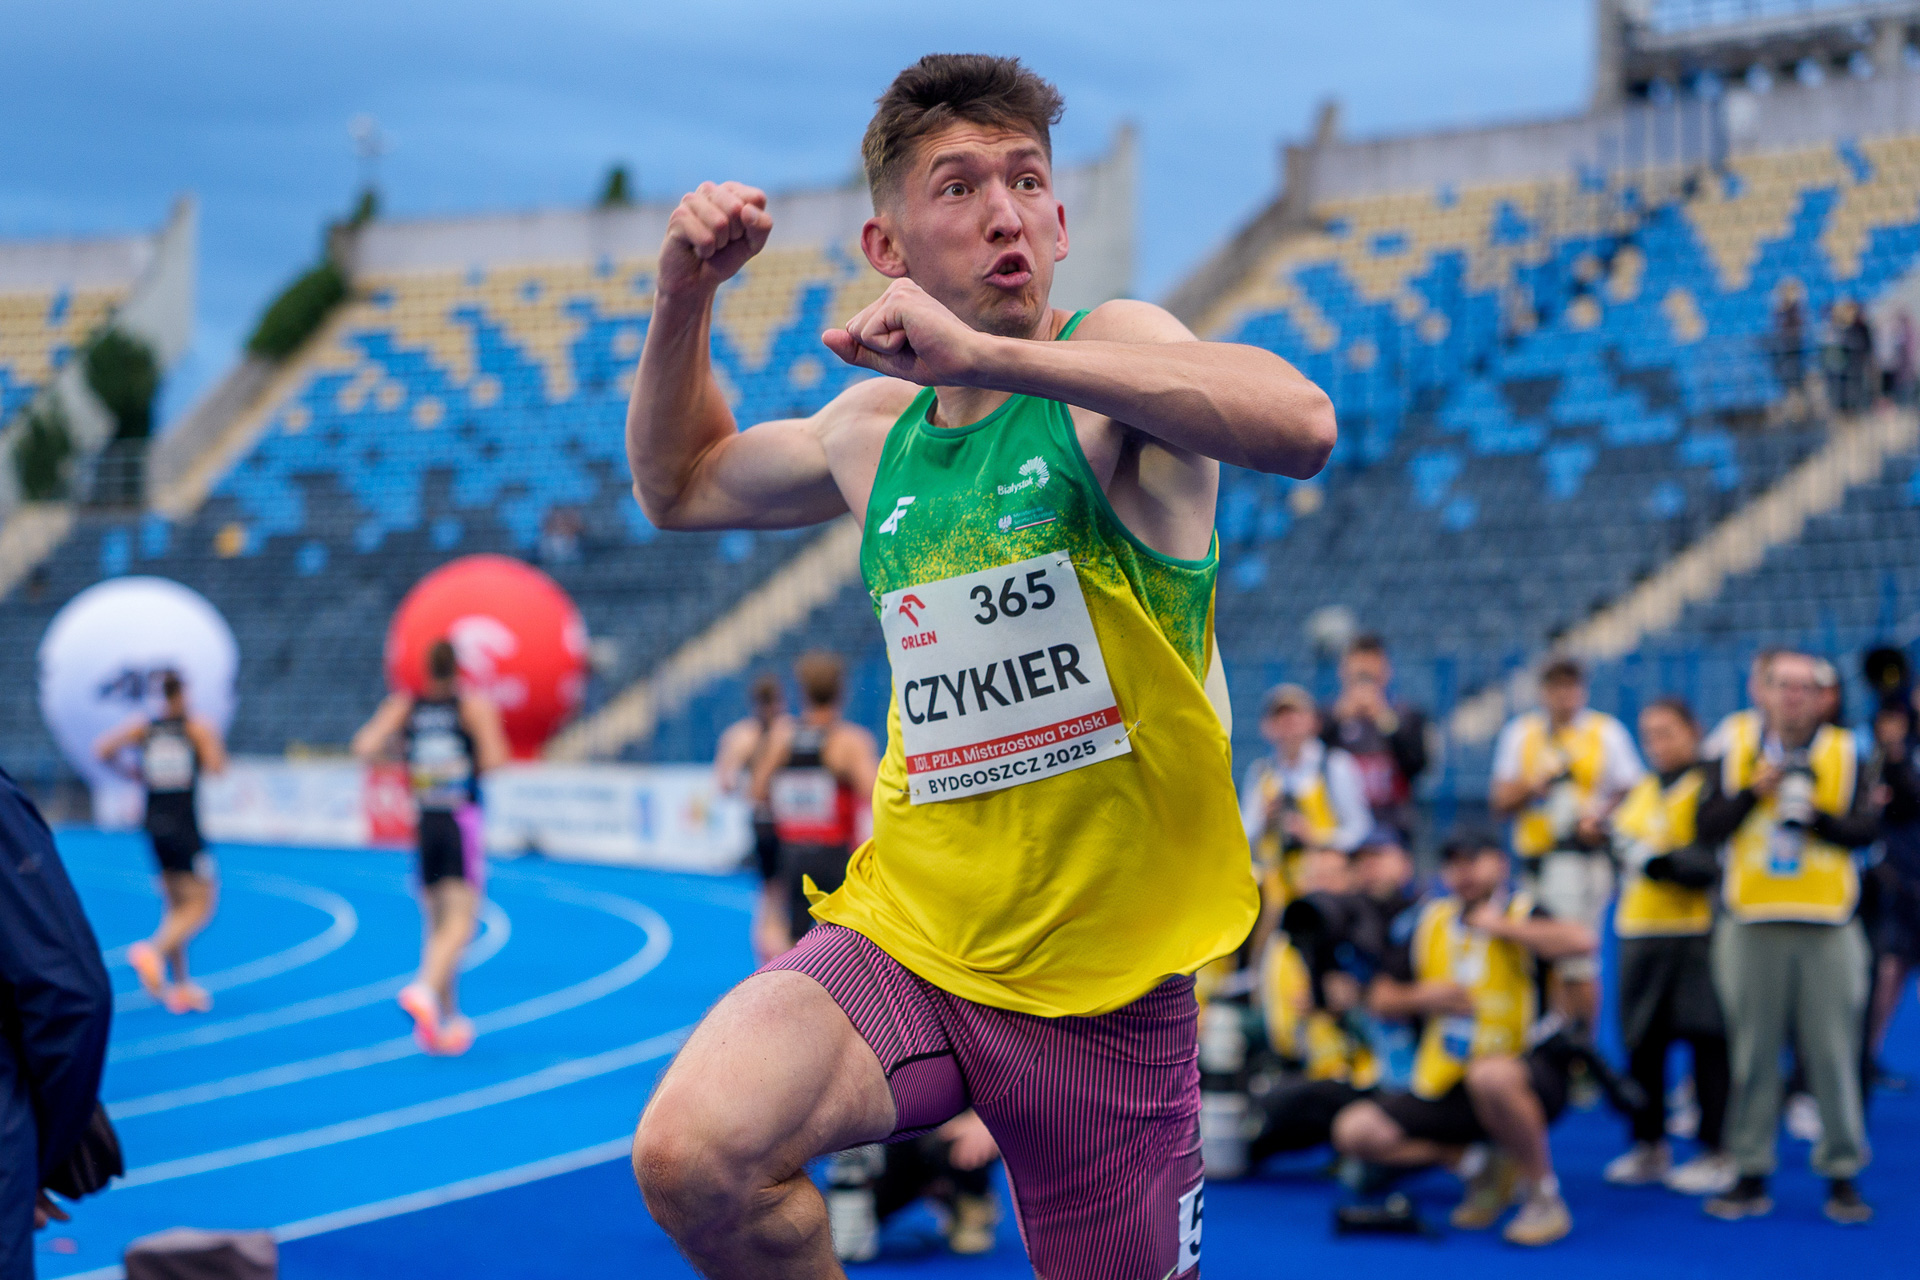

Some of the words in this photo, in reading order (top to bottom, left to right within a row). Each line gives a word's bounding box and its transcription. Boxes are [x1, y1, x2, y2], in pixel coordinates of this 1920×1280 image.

[970, 569, 1055, 625] 365
[901, 631, 938, 650] ORLEN
[905, 643, 1091, 724] CZYKIER
[914, 757, 931, 771] 101.
[932, 750, 962, 767] PZLA
[964, 730, 1056, 762] Mistrzostwa
[1058, 713, 1108, 739] Polski
[928, 757, 1041, 794] BYDGOSZCZ
[1043, 740, 1097, 768] 2025
